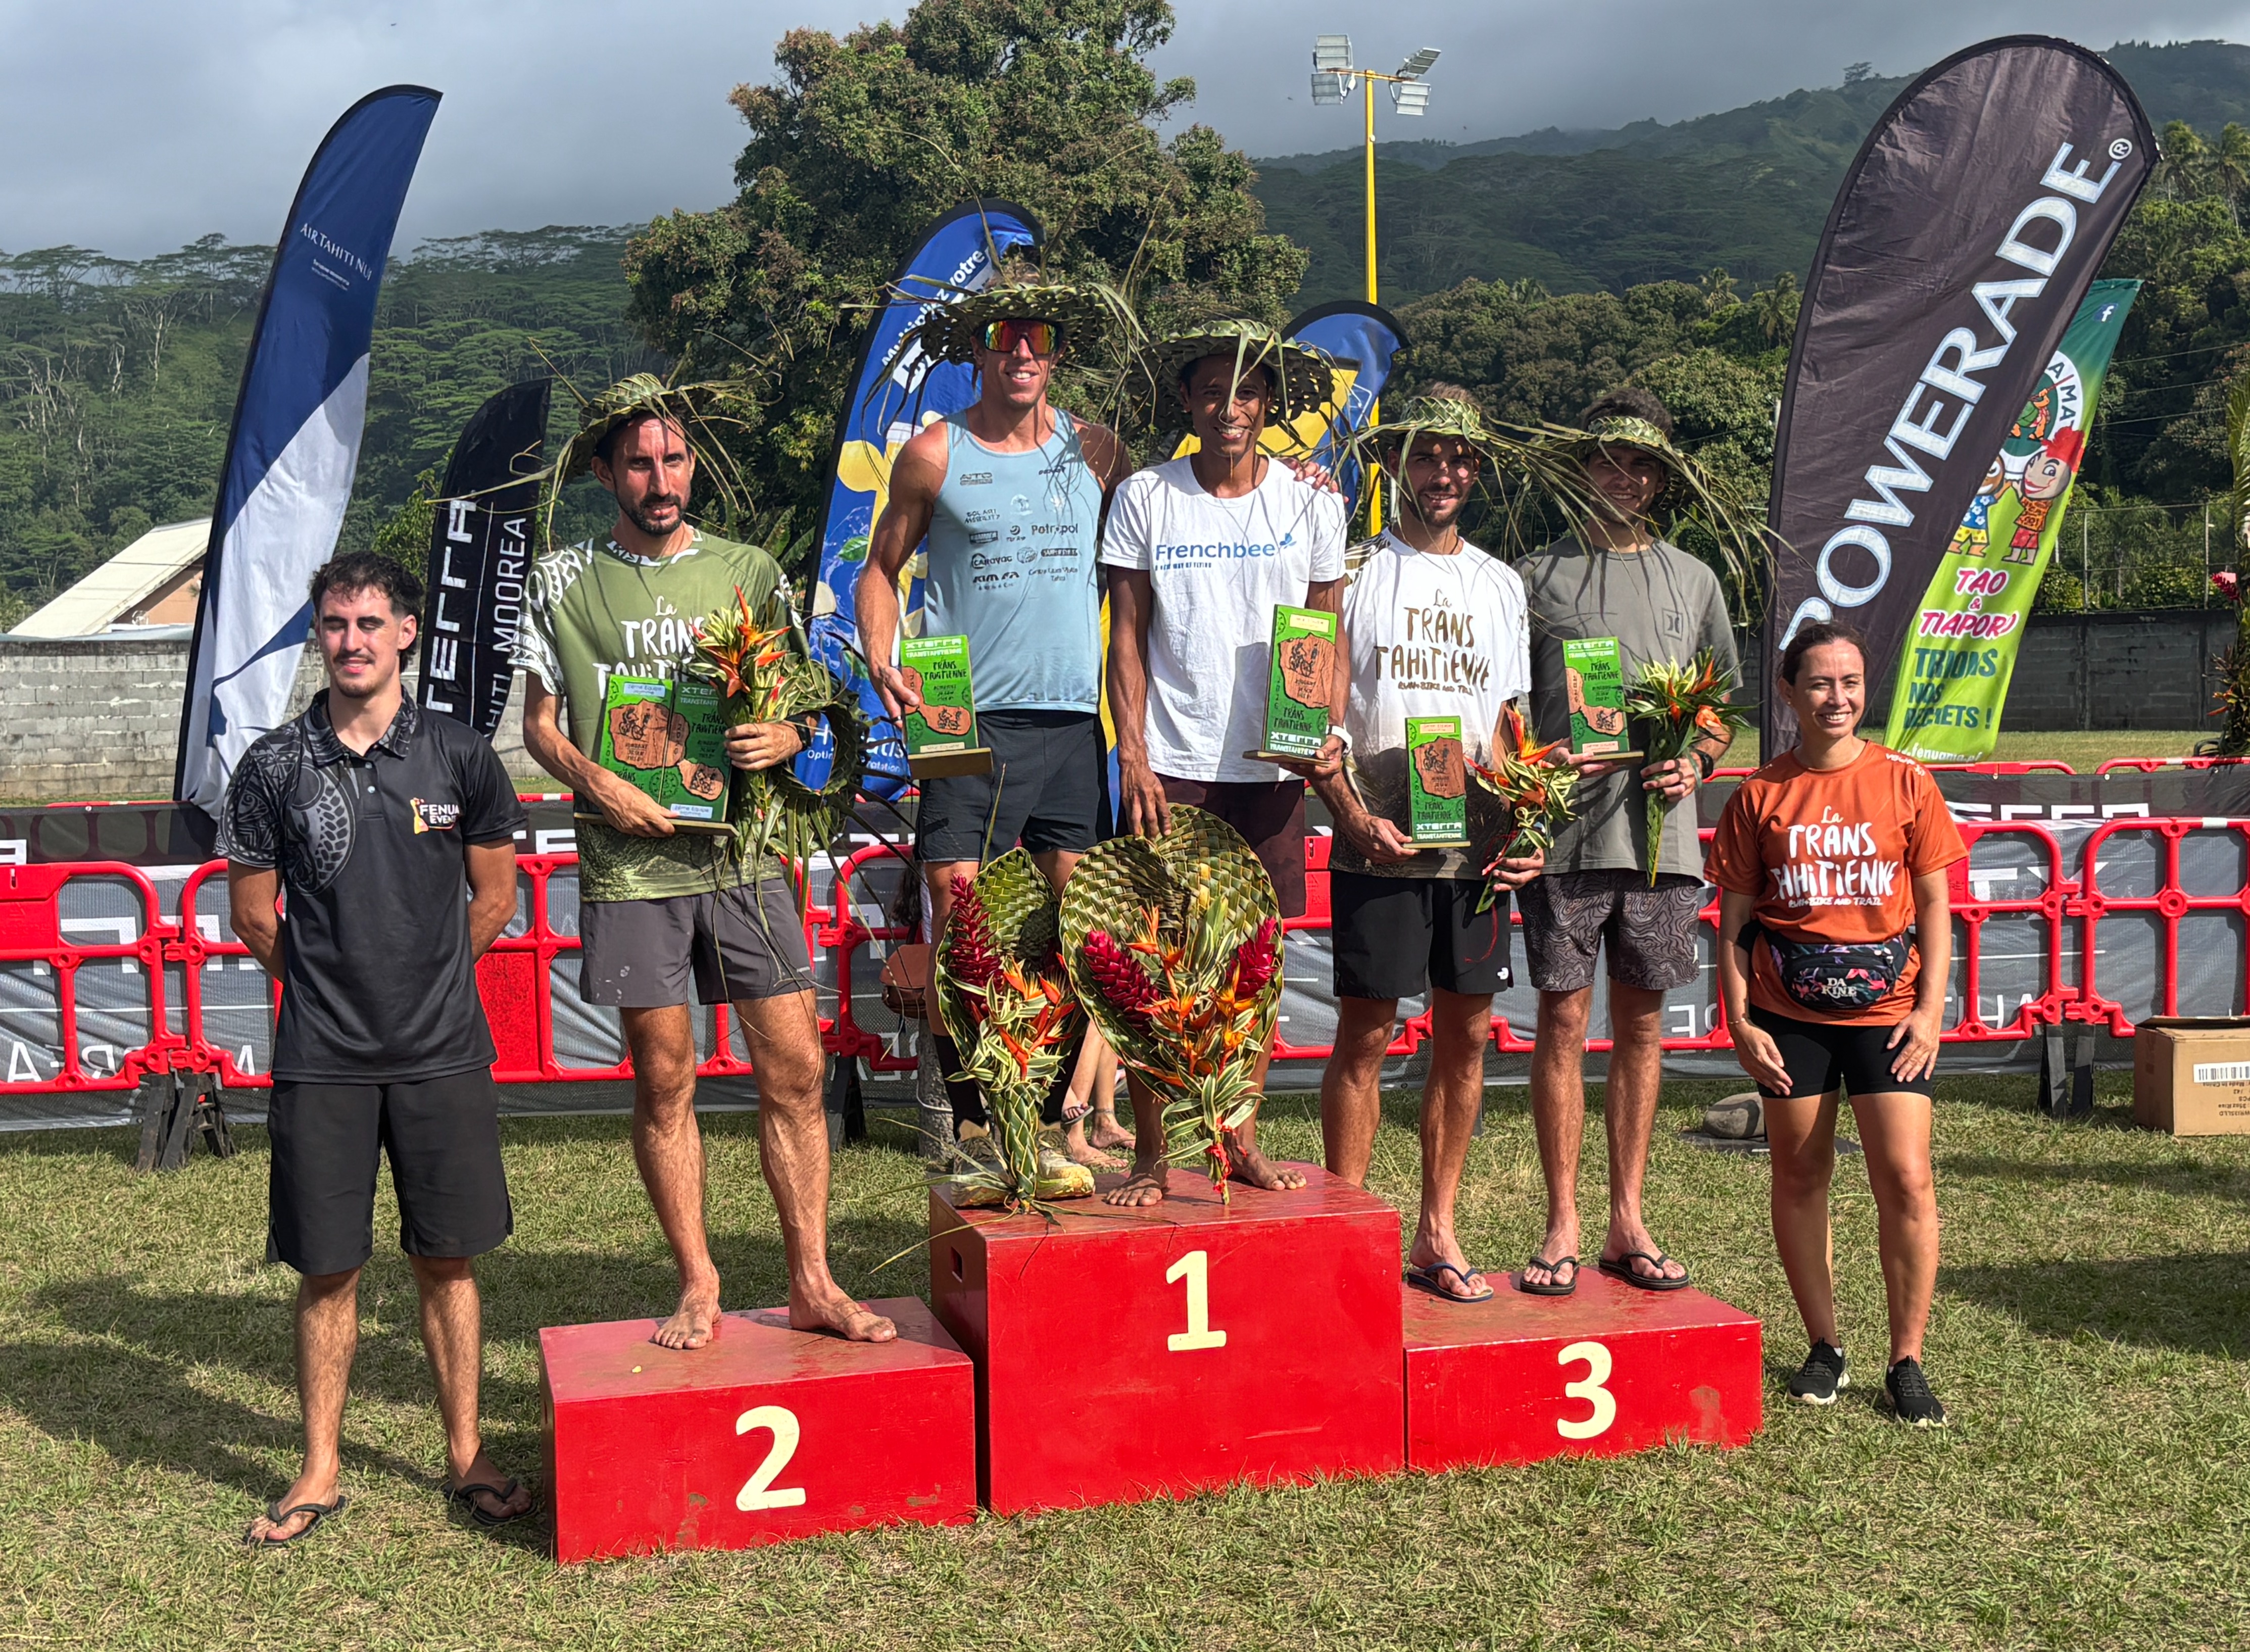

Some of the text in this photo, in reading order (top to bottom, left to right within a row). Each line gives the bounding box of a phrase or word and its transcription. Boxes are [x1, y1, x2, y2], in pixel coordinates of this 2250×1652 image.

[301, 223, 318, 245] AIR
[320, 232, 354, 266] TAHITI
[355, 258, 372, 281] NUI
[1155, 542, 1276, 561] Frenchbee
[493, 518, 526, 653] MOOREA
[1957, 570, 2007, 594] TAO
[655, 596, 677, 616] La
[1403, 607, 1475, 647] TRANS
[419, 804, 460, 816] FENUA
[1821, 805, 1844, 824] La
[1787, 821, 1877, 858] TRANS
[1834, 897, 1852, 906] AND
[1853, 897, 1883, 906] TRAIL
[1827, 978, 1847, 988] DA
[1166, 1251, 1226, 1351] 1
[1557, 1342, 1616, 1438] 3
[736, 1406, 806, 1511] 2
